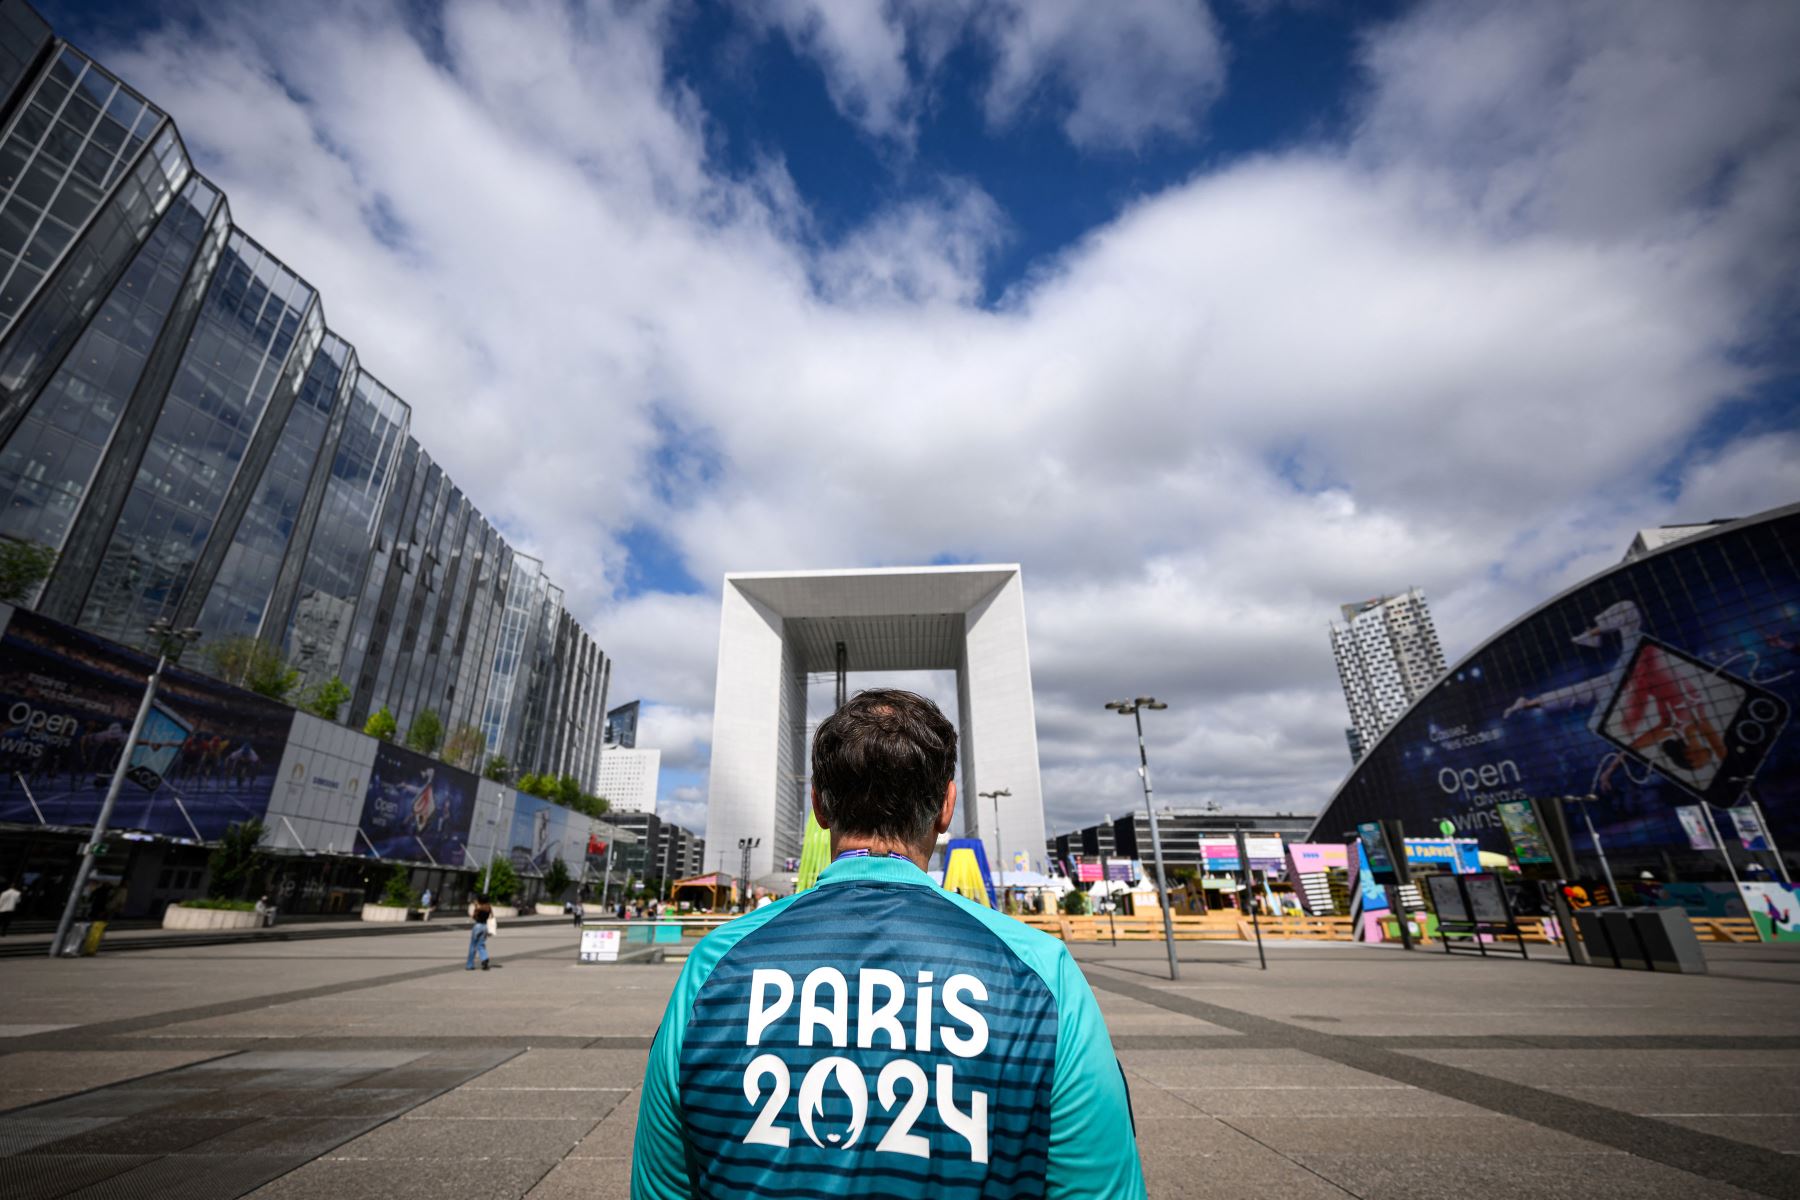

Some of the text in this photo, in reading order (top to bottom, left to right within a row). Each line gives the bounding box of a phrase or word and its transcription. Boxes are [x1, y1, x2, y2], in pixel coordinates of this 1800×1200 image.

[8, 702, 78, 737] Open
[0, 736, 44, 757] wins
[1438, 760, 1521, 799] Open
[375, 797, 398, 813] Open
[1453, 807, 1502, 830] wins
[743, 1054, 988, 1164] 2024
